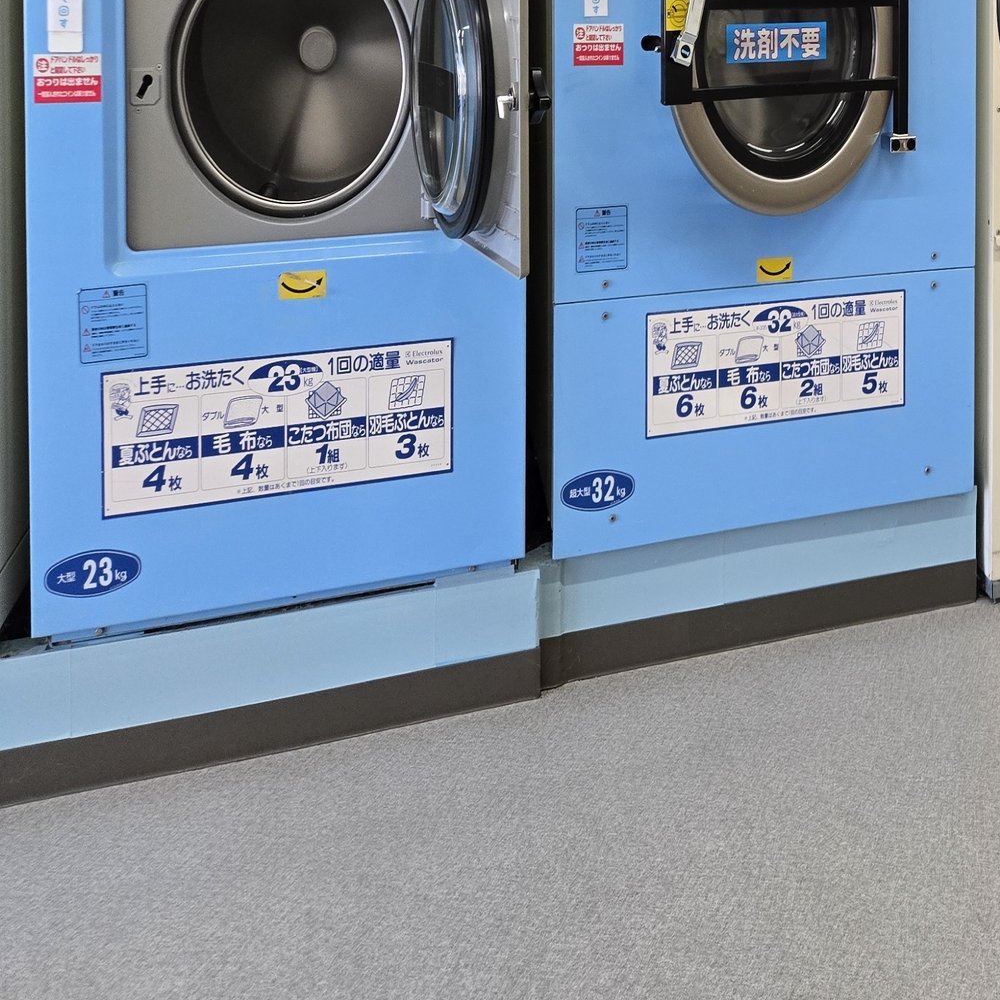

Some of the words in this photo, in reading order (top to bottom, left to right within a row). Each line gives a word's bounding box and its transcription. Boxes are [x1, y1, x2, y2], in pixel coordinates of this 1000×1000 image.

[733, 26, 821, 61] 洗剤不要
[811, 300, 866, 320] 1回の適量
[328, 350, 401, 376] 1回の適量
[406, 357, 444, 365] Wascator
[412, 349, 443, 357] Electrolux
[720, 348, 736, 357] ダブル
[843, 352, 898, 373] 羽毛ぶとんなら
[782, 358, 840, 380] こたつ布団なら
[658, 373, 712, 394] 夏ぶとんなら
[202, 411, 224, 421] ダブル
[369, 410, 444, 434] 羽毛ぶとんなら
[289, 420, 365, 445] こたつ布団なら
[118, 442, 193, 466] 夏ぶとんなら
[569, 486, 591, 499] 超大型
[57, 571, 76, 584] 大型
